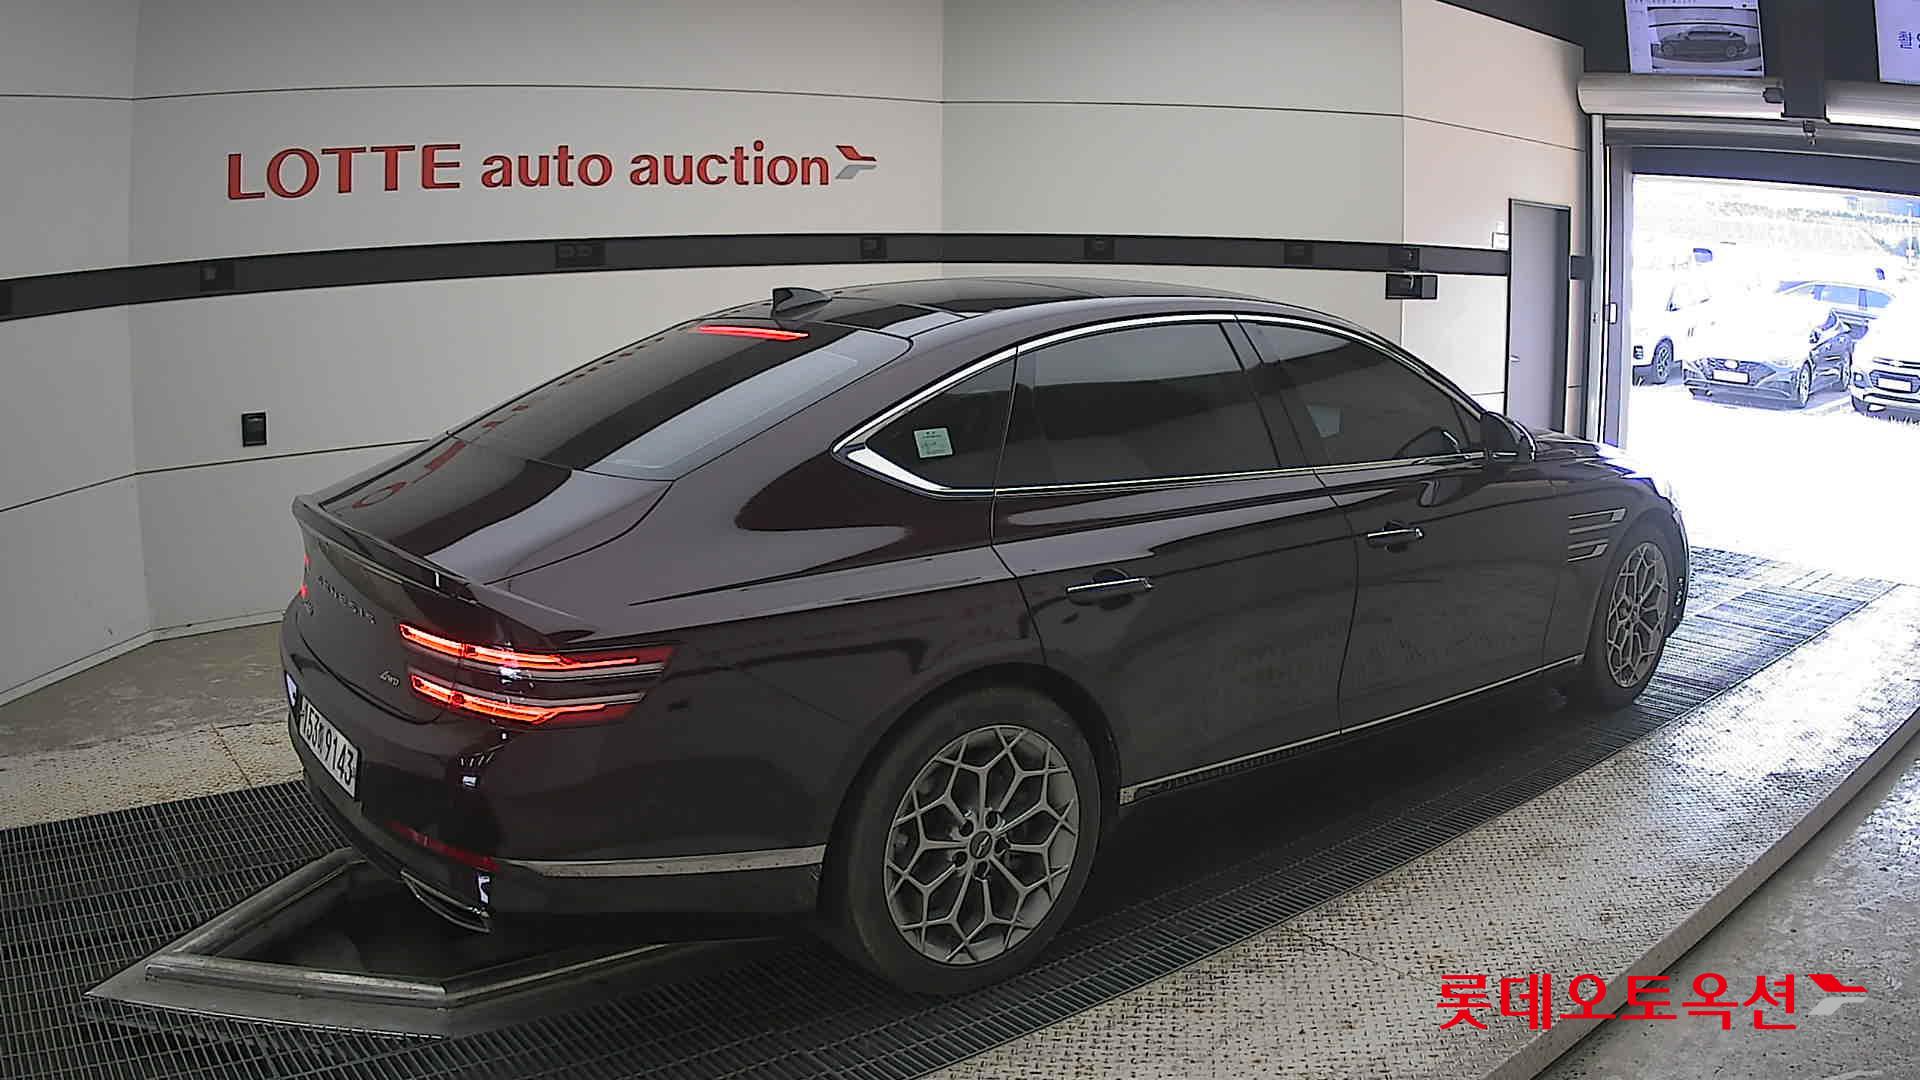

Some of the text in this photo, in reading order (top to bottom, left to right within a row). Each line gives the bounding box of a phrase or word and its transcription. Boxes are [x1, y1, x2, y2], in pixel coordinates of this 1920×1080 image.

[227, 140, 830, 200] LOTTE auto auction
